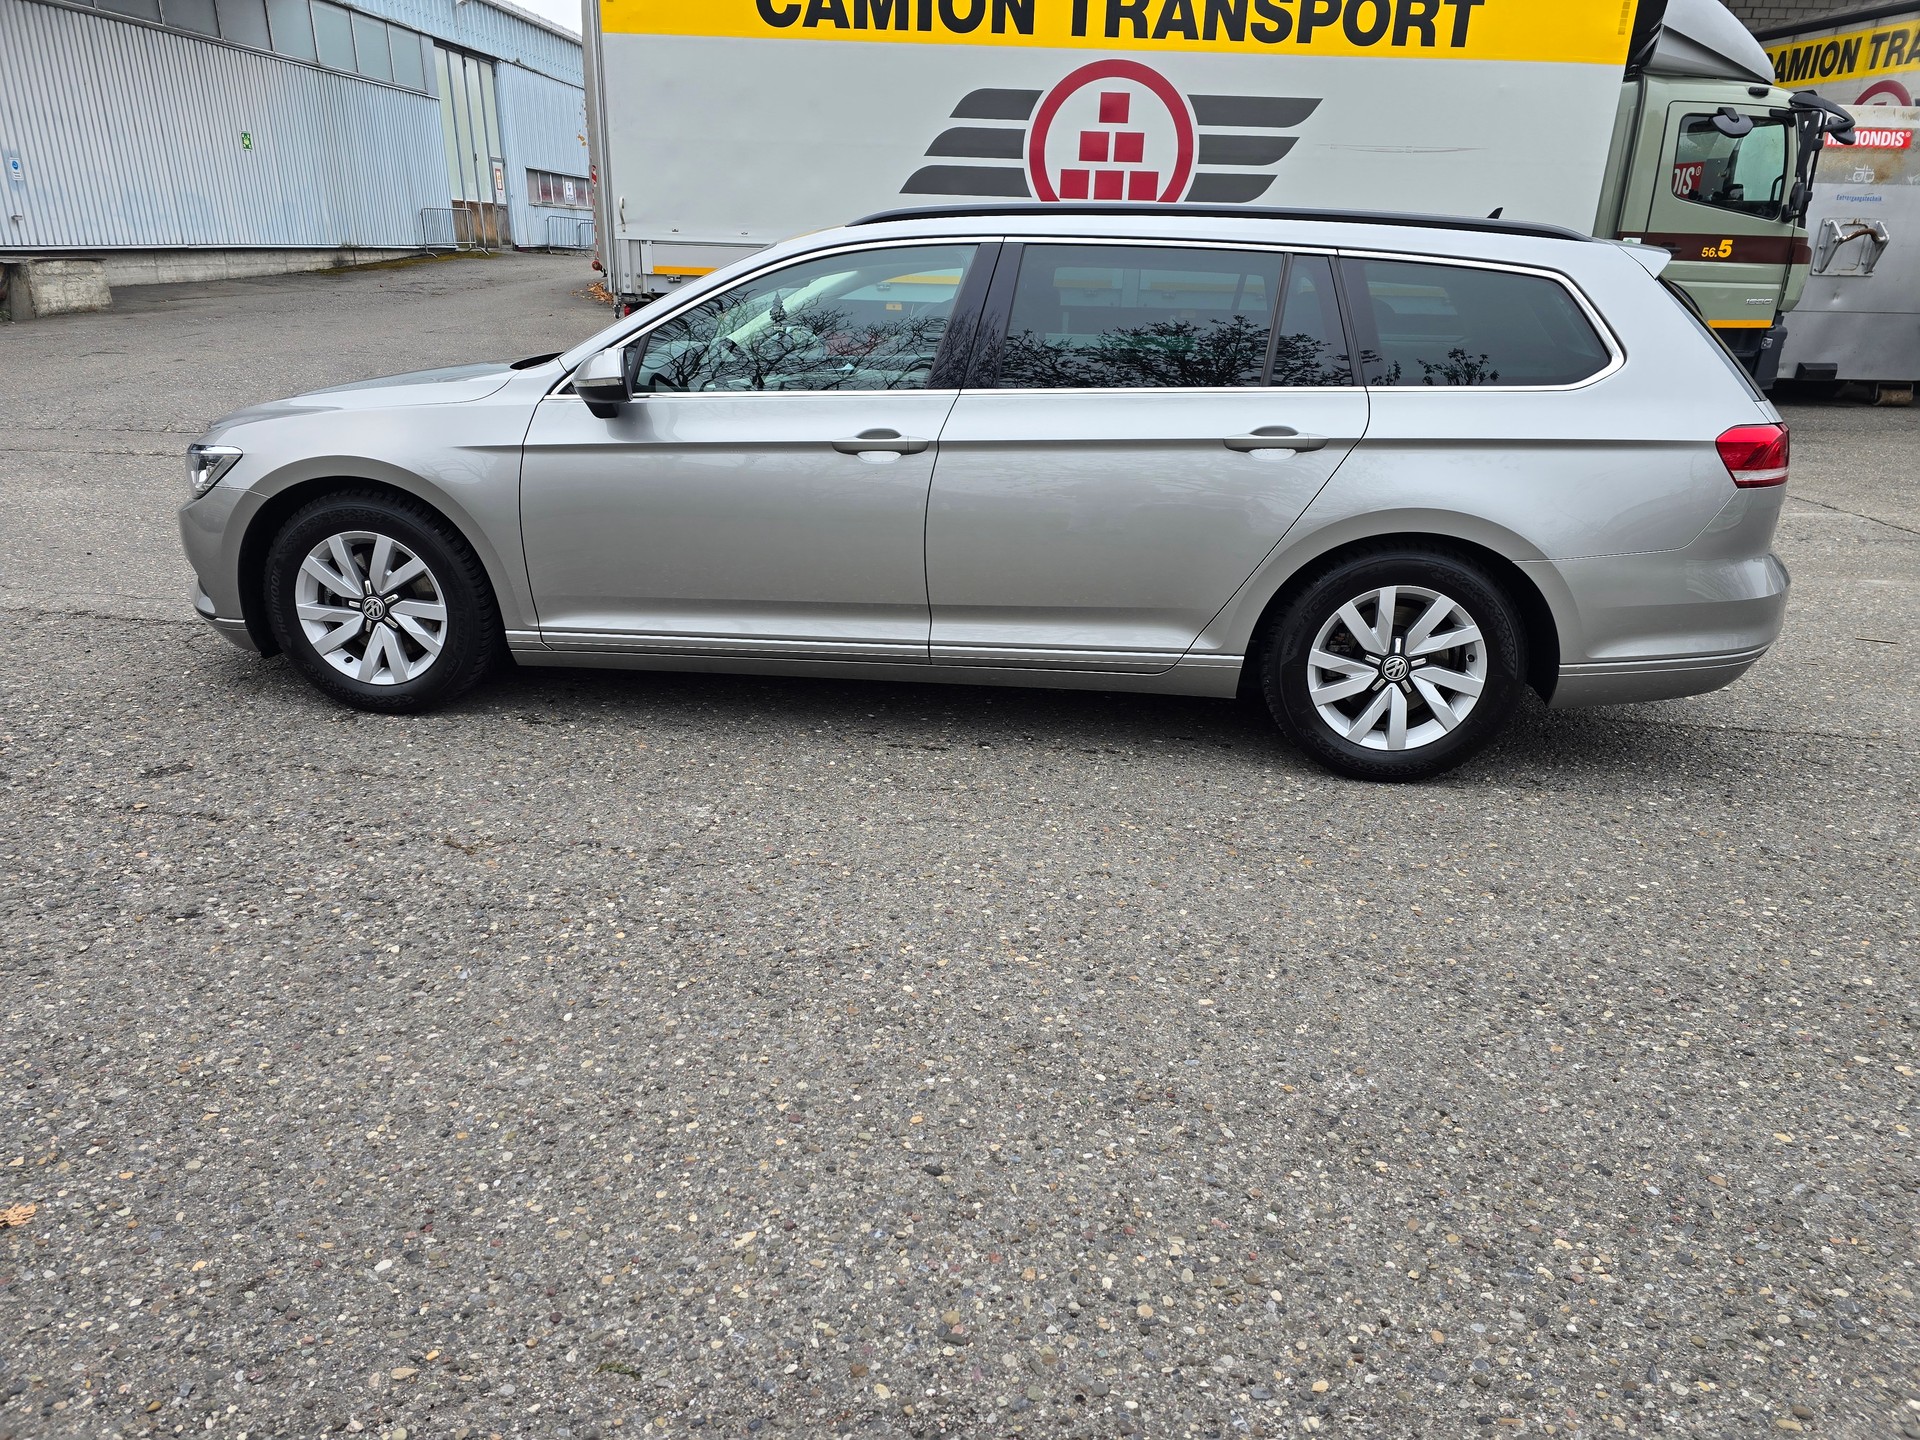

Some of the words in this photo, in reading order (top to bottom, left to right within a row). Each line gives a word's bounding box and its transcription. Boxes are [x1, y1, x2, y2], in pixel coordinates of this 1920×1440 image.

[757, 0, 1035, 35] CAMION
[1071, 0, 1485, 48] TRANSPORT
[1767, 37, 1863, 83] AMION
[1701, 239, 1733, 258] 56.5
